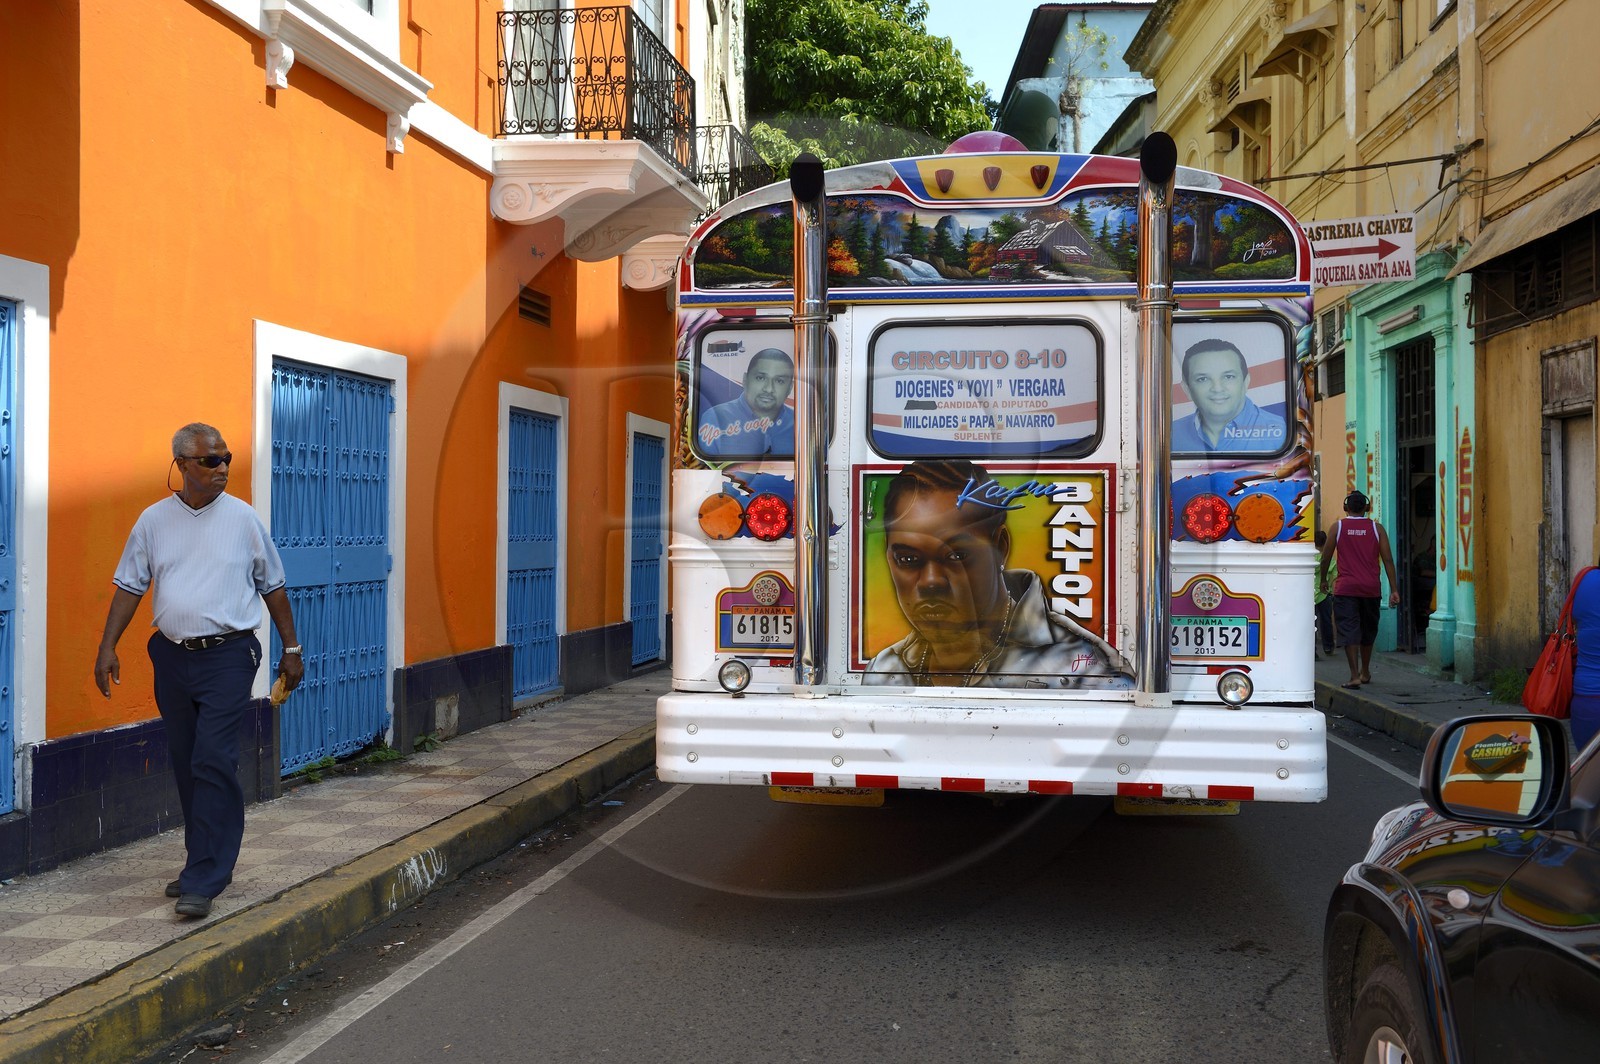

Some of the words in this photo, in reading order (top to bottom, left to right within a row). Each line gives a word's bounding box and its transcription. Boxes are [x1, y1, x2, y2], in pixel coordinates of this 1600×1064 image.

[1367, 217, 1413, 237] CHAVEZ
[1314, 264, 1357, 286] UQUERIA
[1358, 261, 1389, 280] SANTA
[1391, 260, 1412, 277] ANA
[892, 350, 1009, 370] CIRCUITO
[1015, 349, 1067, 369] 8-10
[895, 379, 954, 398] DIOGENES
[1009, 378, 1066, 397] VERGARA
[937, 401, 989, 409] CANDIDATO
[992, 401, 999, 409] A
[1001, 400, 1048, 409] DIPUTADO
[903, 415, 959, 429] MILCIADES
[1005, 414, 1055, 428] NAVARRO
[953, 432, 1002, 441] SUPLENTE
[1224, 427, 1283, 438] Navarro
[1049, 481, 1097, 619] BANTON
[753, 607, 787, 615] PANAMA
[1187, 618, 1223, 626] PANAMA
[760, 635, 780, 643] 2012
[1171, 626, 1242, 648] 618152
[1194, 647, 1216, 655] 2013
[1471, 745, 1513, 758] CASINO
